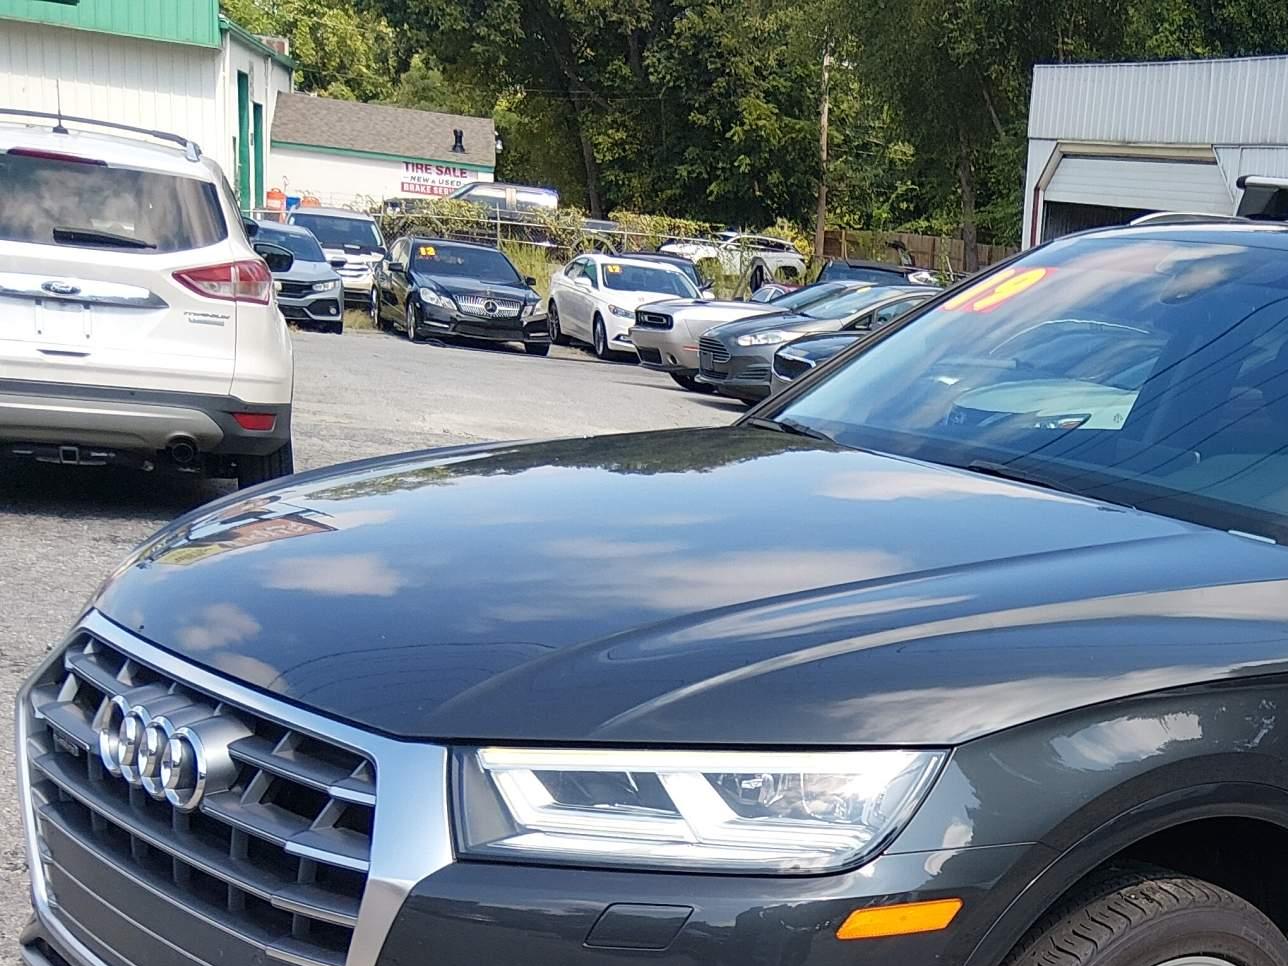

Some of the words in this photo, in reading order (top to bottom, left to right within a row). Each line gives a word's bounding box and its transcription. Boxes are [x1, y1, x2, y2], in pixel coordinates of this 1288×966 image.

[402, 161, 432, 175] TIRE
[435, 166, 468, 179] SALE
[410, 175, 430, 183] NEW
[438, 179, 462, 187] USED
[403, 183, 432, 194] BRAKE
